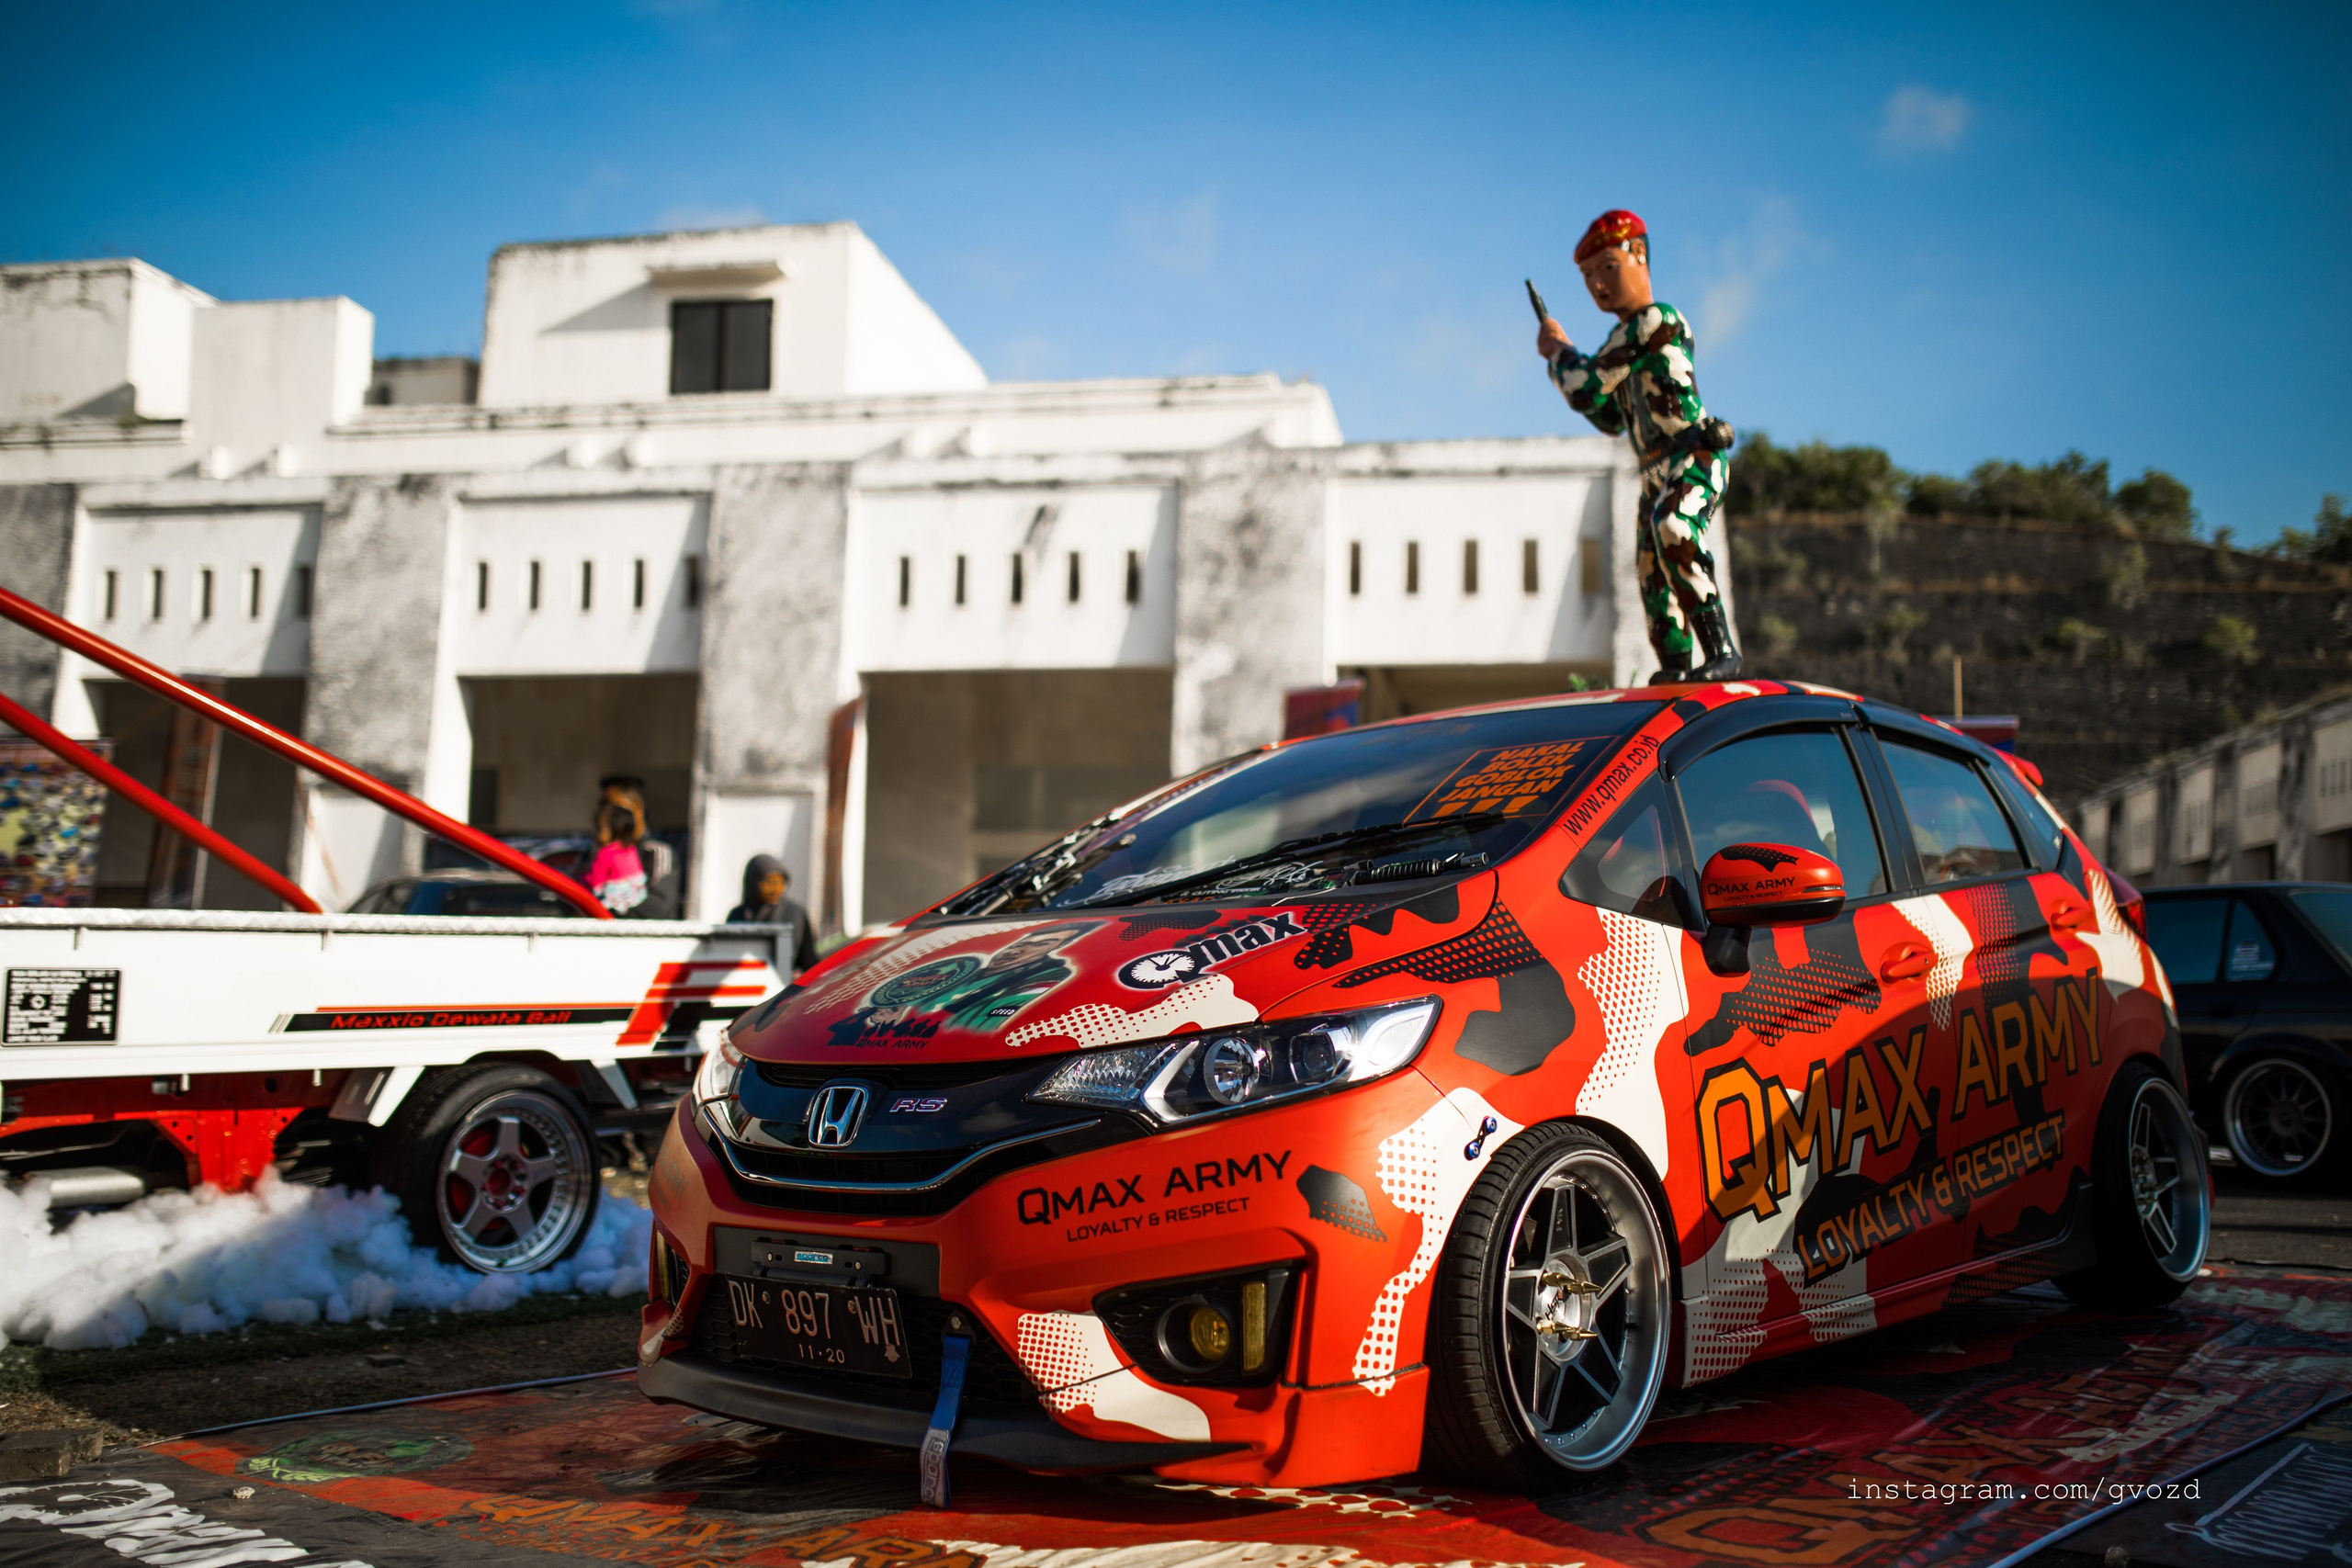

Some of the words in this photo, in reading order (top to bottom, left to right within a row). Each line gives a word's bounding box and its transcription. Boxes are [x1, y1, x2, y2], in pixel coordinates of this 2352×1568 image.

[1479, 752, 1575, 773] BOLEH
[1490, 741, 1586, 762] NAKAL
[1455, 764, 1576, 788] GOBLOK
[1563, 734, 1660, 836] www.qmax.co.id
[1439, 778, 1563, 803] JANGAN
[1707, 882, 1750, 897] QMAX
[1755, 876, 1795, 891] ARMY
[1756, 890, 1782, 898] RESPECT
[1118, 912, 1308, 989] Qmax
[525, 1010, 572, 1025] Bali
[855, 1037, 891, 1049] QMAX
[892, 1039, 930, 1050] ARMY
[889, 1098, 947, 1113] RS
[1697, 1023, 1933, 1224] QMAX
[1951, 967, 2103, 1123] ARMY
[1017, 1175, 1145, 1226] QMAX
[1163, 1150, 1292, 1198] ARMY
[1796, 1179, 1933, 1289] LOYALTY
[1930, 1163, 1953, 1213] &
[1952, 1109, 2066, 1203] RESPECT
[1067, 1215, 1143, 1242] LOYALTY
[1148, 1213, 1159, 1226] &
[1165, 1197, 1250, 1224] RESPECT
[728, 1280, 763, 1329] DK
[781, 1289, 831, 1340] 897
[854, 1296, 900, 1347] WH
